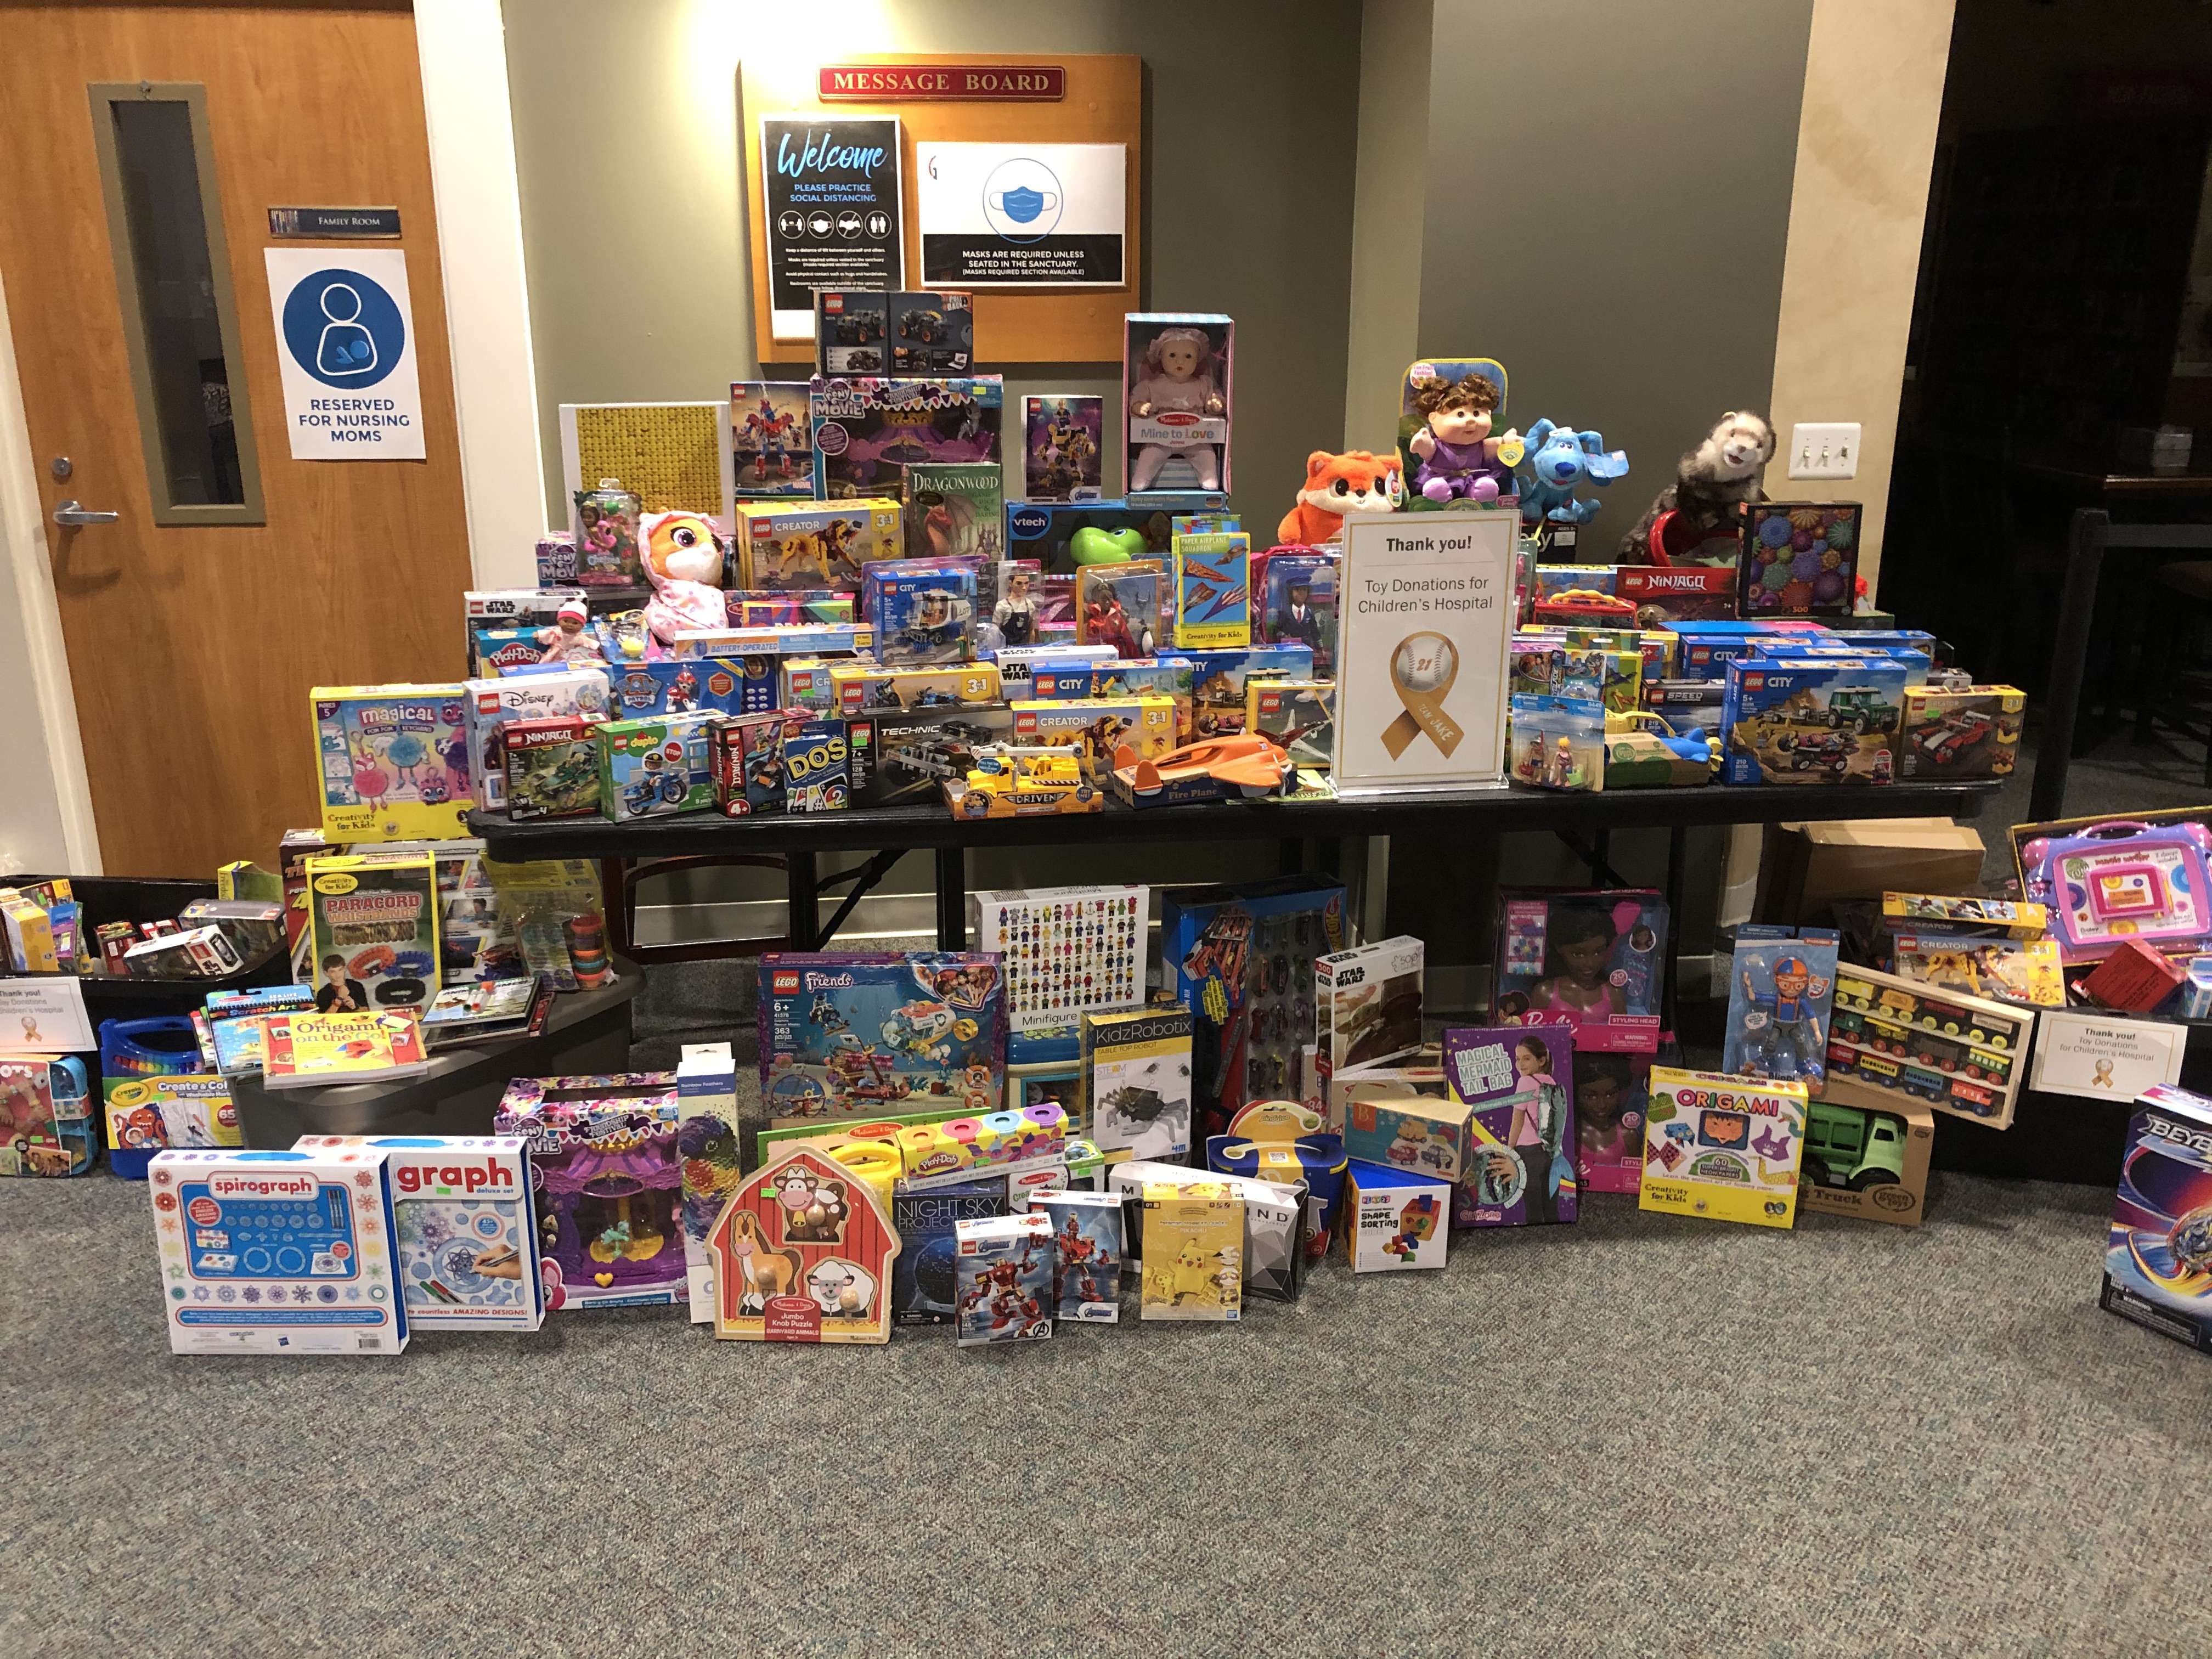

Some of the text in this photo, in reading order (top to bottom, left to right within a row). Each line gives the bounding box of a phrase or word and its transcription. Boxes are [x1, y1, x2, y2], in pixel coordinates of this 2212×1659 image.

[833, 73, 1049, 91] MESSAGE BOARD
[777, 128, 889, 178] Welcome
[794, 183, 872, 192] PLEASE PRACTICE
[789, 194, 877, 202] SOCIAL DISTANCING
[1011, 251, 1052, 259] REQUIRED
[311, 399, 395, 411] RESERVED
[299, 415, 410, 427] FOR NURSING
[331, 431, 382, 442] MOMS
[1141, 427, 1215, 439] Mine to Love
[913, 472, 999, 493] DRAGONWOOD
[775, 521, 820, 532] CREATOR
[1014, 517, 1045, 527] vtech
[1181, 537, 1227, 545] PAPER AIRPLANE
[1386, 535, 1472, 554] Thank you!
[899, 584, 916, 592] CITY
[1365, 575, 1489, 596] Toy Donations for
[1626, 574, 1708, 591] LEGO NINJAGO
[1358, 595, 1493, 614] Children's Hospital
[490, 647, 540, 666] Play-Doh
[1692, 651, 1739, 662] LEGO CITY
[1417, 658, 1432, 672] 21
[793, 678, 811, 687] LEGO
[1037, 679, 1084, 690] LEGO CITY
[1745, 676, 1793, 688] LEGO CITY
[844, 689, 862, 697] LEGO
[1667, 692, 1703, 702] SPEED
[1263, 698, 1279, 707] LEGO
[1418, 703, 1433, 721] TEAM
[1018, 716, 1088, 727] LEGO CREATOR
[852, 730, 869, 738] LEGO
[881, 724, 941, 736] TECHNIC
[1430, 718, 1454, 742] JAKE
[524, 729, 576, 746] NINJAGO
[665, 748, 681, 757] STOP
[787, 738, 848, 781] DOS
[729, 746, 741, 787] NINJAGO
[1016, 793, 1057, 805] DRIVEN
[1168, 788, 1217, 800] Fire Plane
[730, 803, 748, 815] 4+
[327, 814, 376, 823] Creativity
[336, 820, 376, 831] for Kids
[318, 877, 352, 885] Creativity
[325, 894, 420, 912] PARACORD
[327, 907, 417, 923] WRISTBANDS
[1921, 941, 1969, 950] CREATOR
[1318, 963, 1331, 974] 500
[1336, 966, 1365, 980] STAR
[774, 972, 854, 992] LEGO Friends
[1336, 974, 1365, 988] WARS
[229, 1004, 297, 1017] Scratch Art
[774, 1003, 789, 1012] 6+
[1022, 1011, 1077, 1026] Minifigure
[1097, 1015, 1191, 1043] KidzRobotix
[2084, 1028, 2136, 1041] Thank you!
[296, 1028, 387, 1043] on the Go!
[1097, 1047, 1118, 1056] TABLE
[1132, 1042, 1158, 1051] ROBOT
[2079, 1036, 2138, 1050] Toy Donations
[1455, 1043, 1508, 1066] MAGICAL
[2059, 1043, 2155, 1062] for Children's Hospital
[1459, 1058, 1513, 1082] MERMAID
[157, 1081, 198, 1092] Create
[1462, 1073, 1514, 1096] TAIL BAG
[1677, 1088, 1779, 1118] ORIGAMI
[218, 1109, 235, 1119] 65
[1172, 1143, 1187, 1152] 4M
[919, 1154, 957, 1171] Play-Doh
[1714, 1157, 1728, 1166] 60
[397, 1157, 514, 1193] graph
[215, 1177, 312, 1195] spirograph
[1644, 1183, 1689, 1197] Creativity
[1651, 1192, 1687, 1204] for Kids
[1814, 1188, 1863, 1206] Truck
[898, 1198, 1002, 1218] NIGHT SKY
[1361, 1211, 1391, 1220] SHAPE
[781, 1312, 804, 1321] Jumbo
